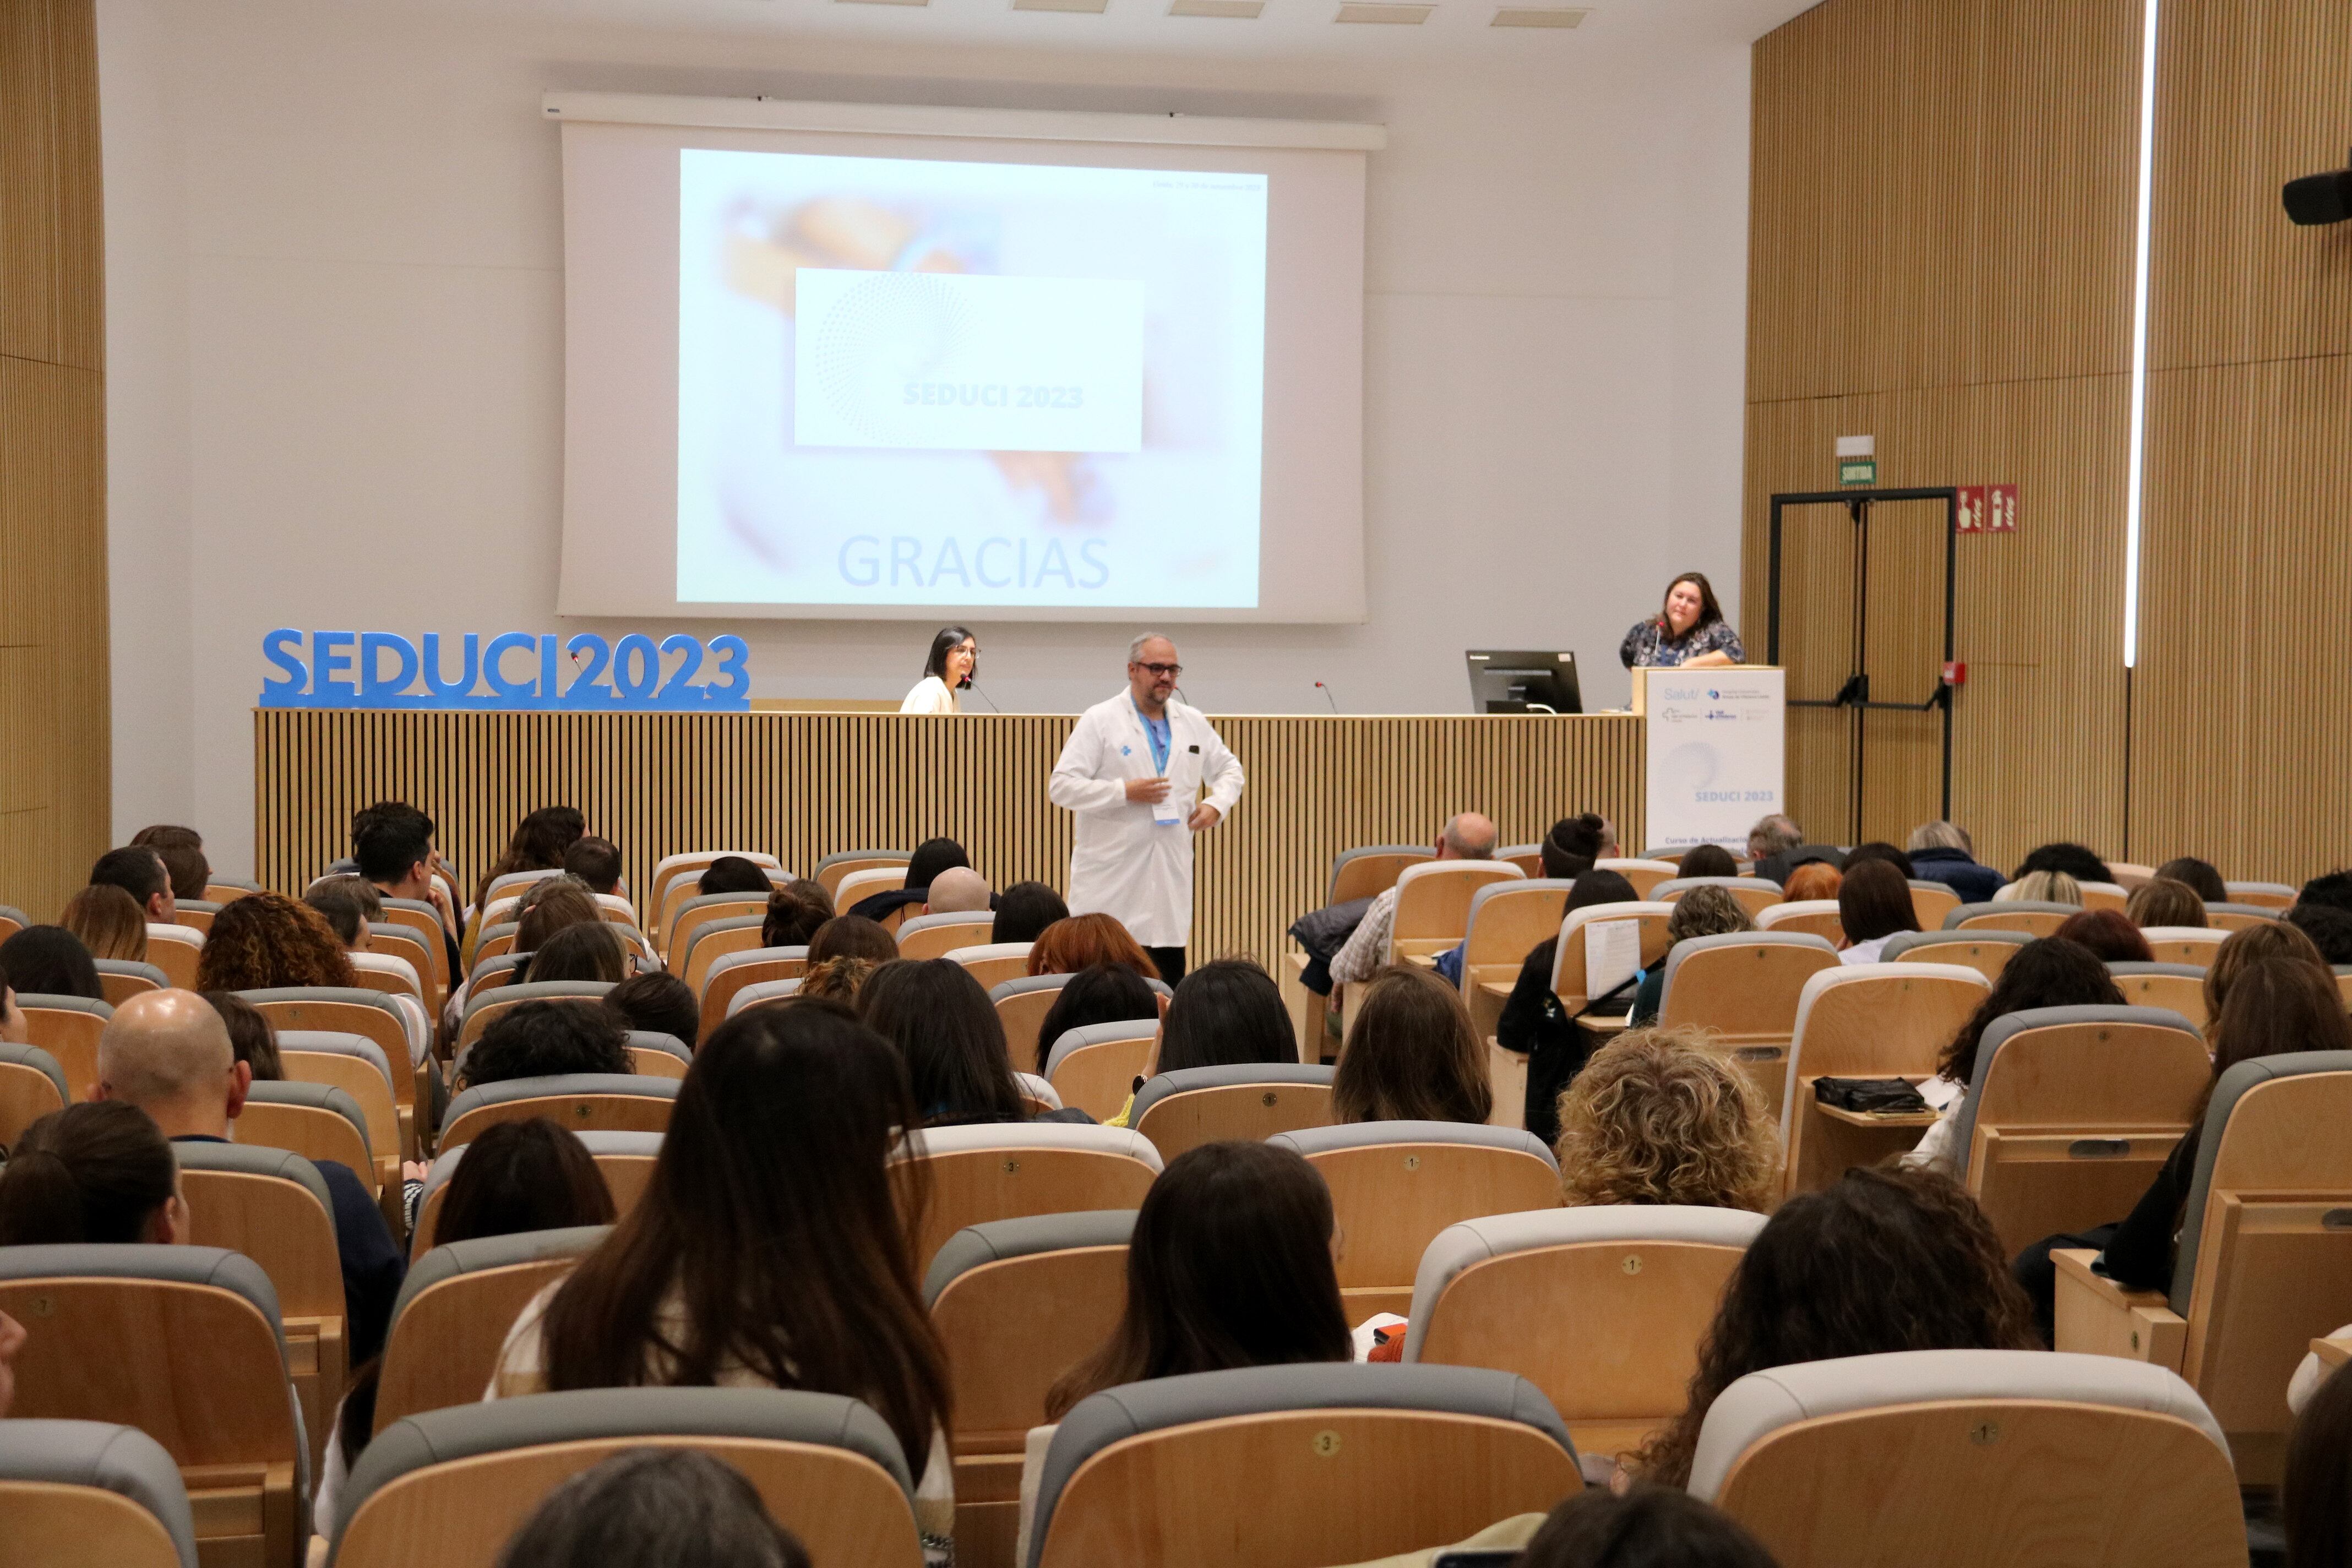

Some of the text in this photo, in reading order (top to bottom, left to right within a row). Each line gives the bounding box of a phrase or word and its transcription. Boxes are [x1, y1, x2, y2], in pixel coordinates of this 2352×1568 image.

[903, 381, 1084, 409] SEDUCI 2023
[838, 534, 1110, 590] GRACIAS
[1695, 791, 1773, 802] SEDUCI 2023
[1009, 1162, 1014, 1172] 3
[1409, 1158, 1414, 1167] 1
[1630, 1259, 1634, 1270] 1
[1982, 1425, 1987, 1439] 1
[1322, 1435, 1331, 1451] 3
